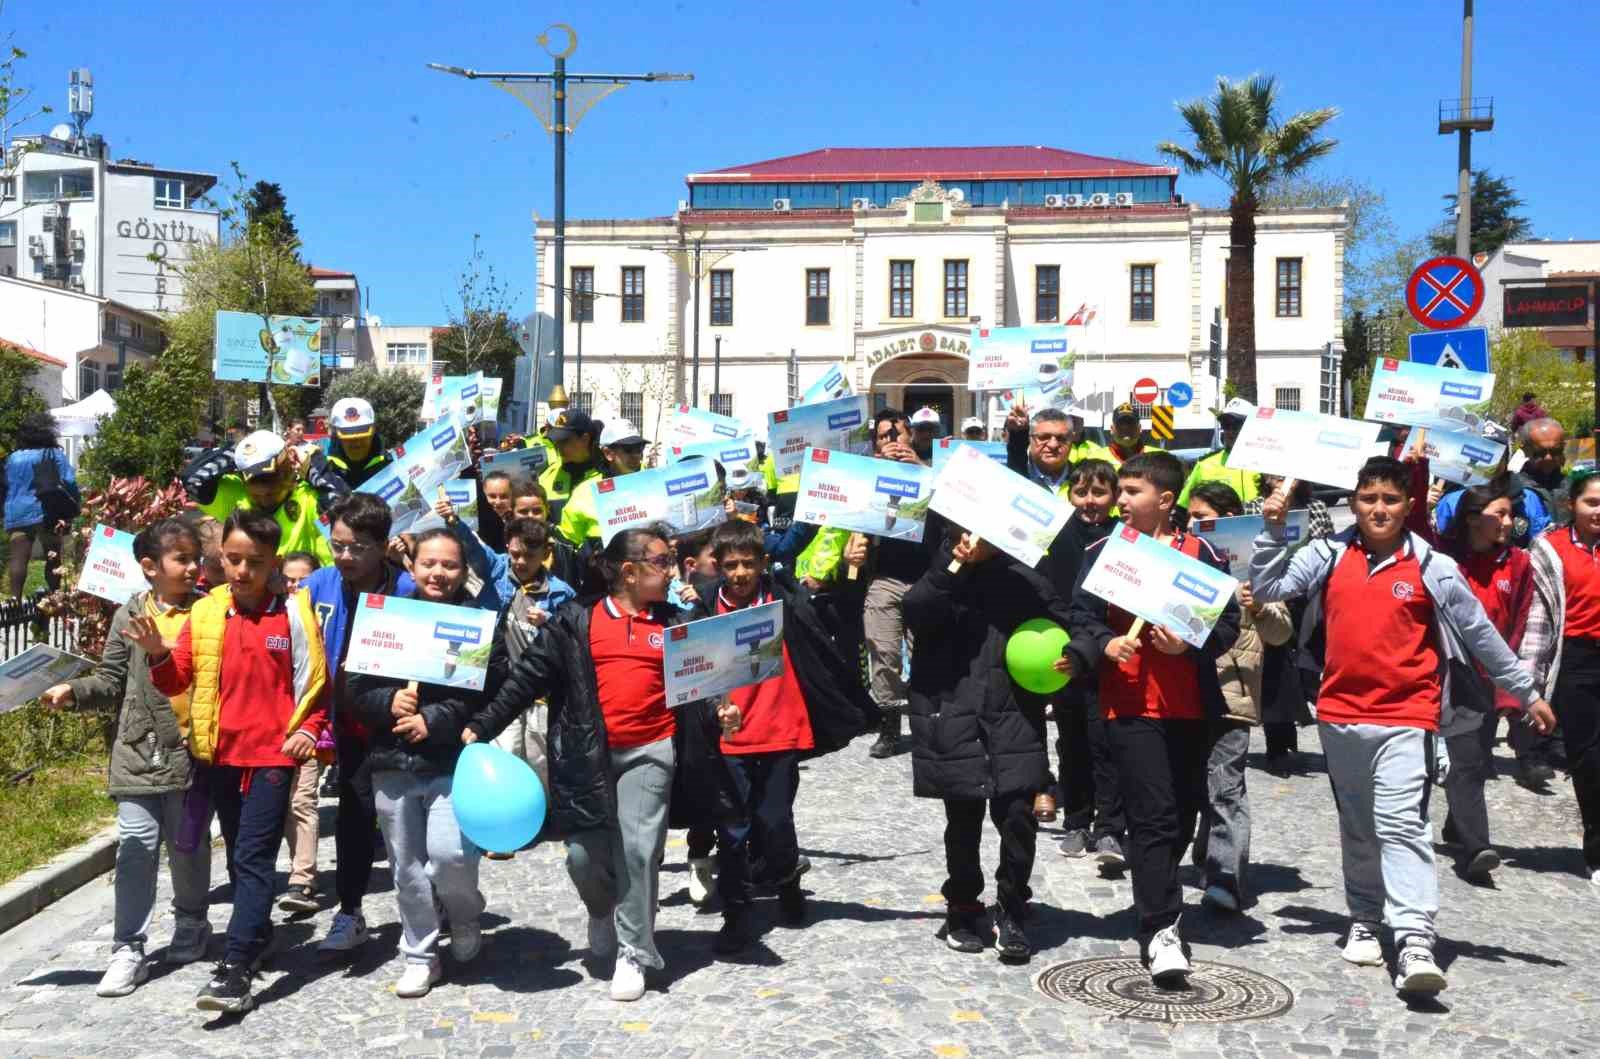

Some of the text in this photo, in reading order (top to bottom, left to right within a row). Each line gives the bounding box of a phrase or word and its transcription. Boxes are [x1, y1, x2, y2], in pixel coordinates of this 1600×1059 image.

[117, 217, 202, 242] GÖNÜL
[866, 336, 971, 368] ADALET SAR
